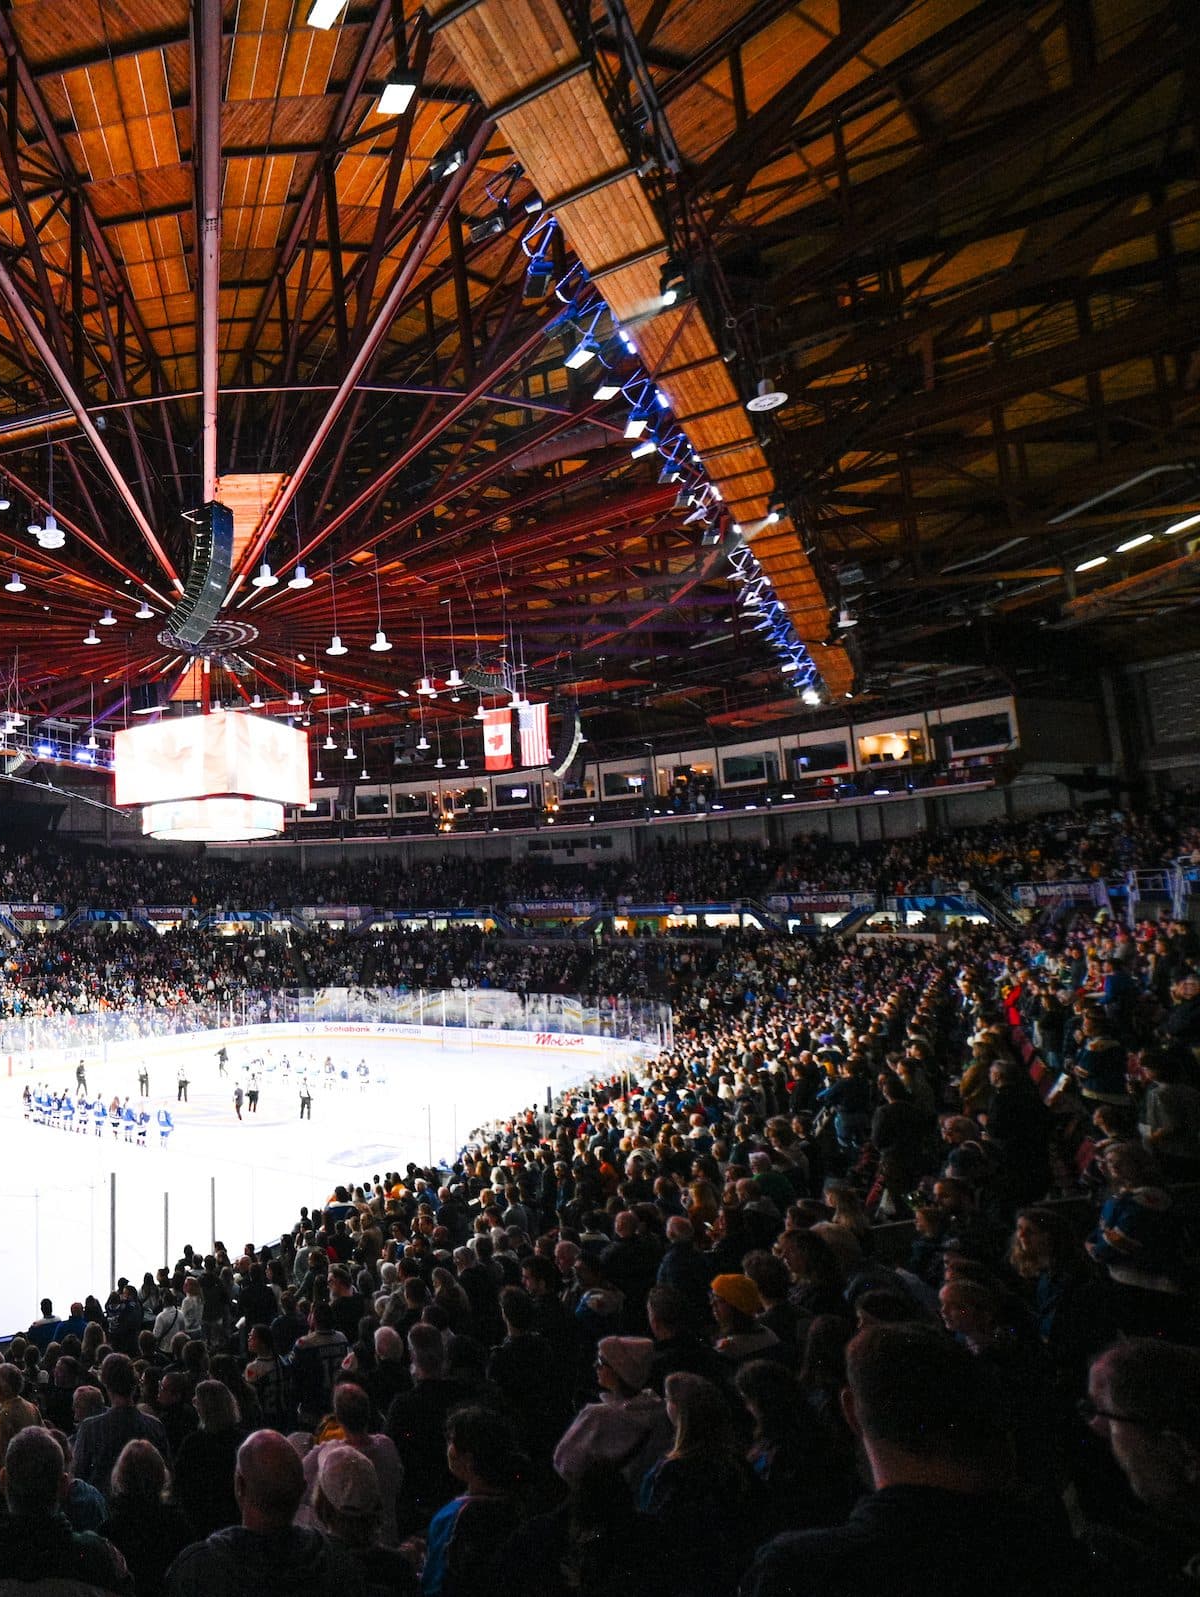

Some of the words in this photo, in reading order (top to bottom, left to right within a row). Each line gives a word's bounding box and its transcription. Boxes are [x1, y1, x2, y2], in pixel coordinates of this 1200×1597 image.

[791, 894, 851, 904] VANCUVER
[11, 905, 45, 913] VANCUVER
[525, 902, 574, 910] VANCUVER
[324, 1024, 371, 1033] Scotiabank
[535, 1032, 584, 1046] Molson
